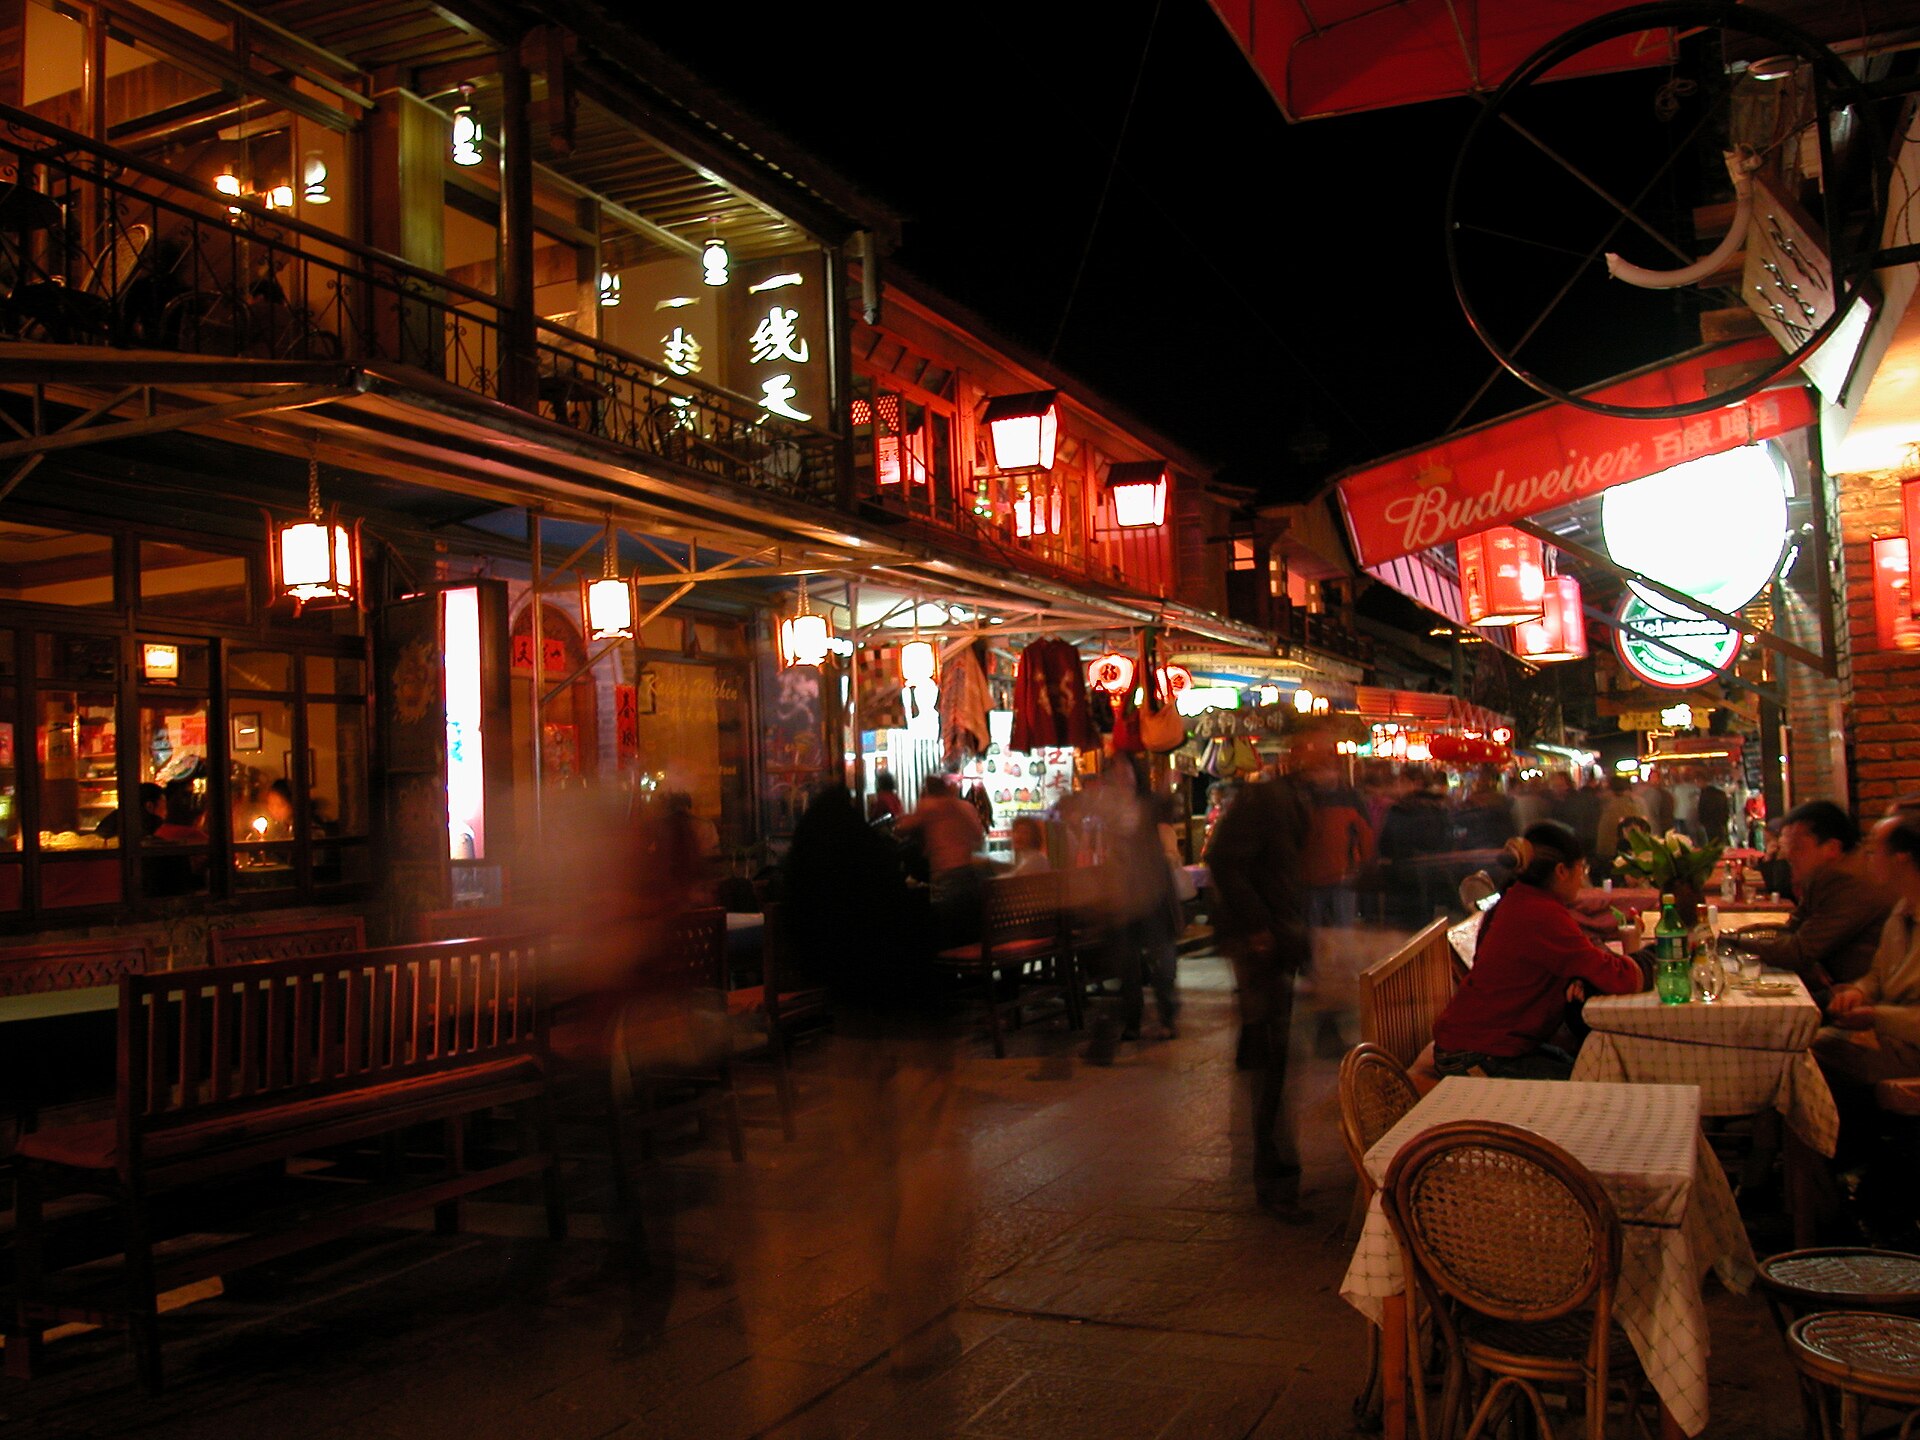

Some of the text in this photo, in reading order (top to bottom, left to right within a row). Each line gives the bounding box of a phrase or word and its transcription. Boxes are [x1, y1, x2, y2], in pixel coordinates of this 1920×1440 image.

[749, 272, 813, 425] 一线天
[1384, 442, 1642, 550] Budweiser
